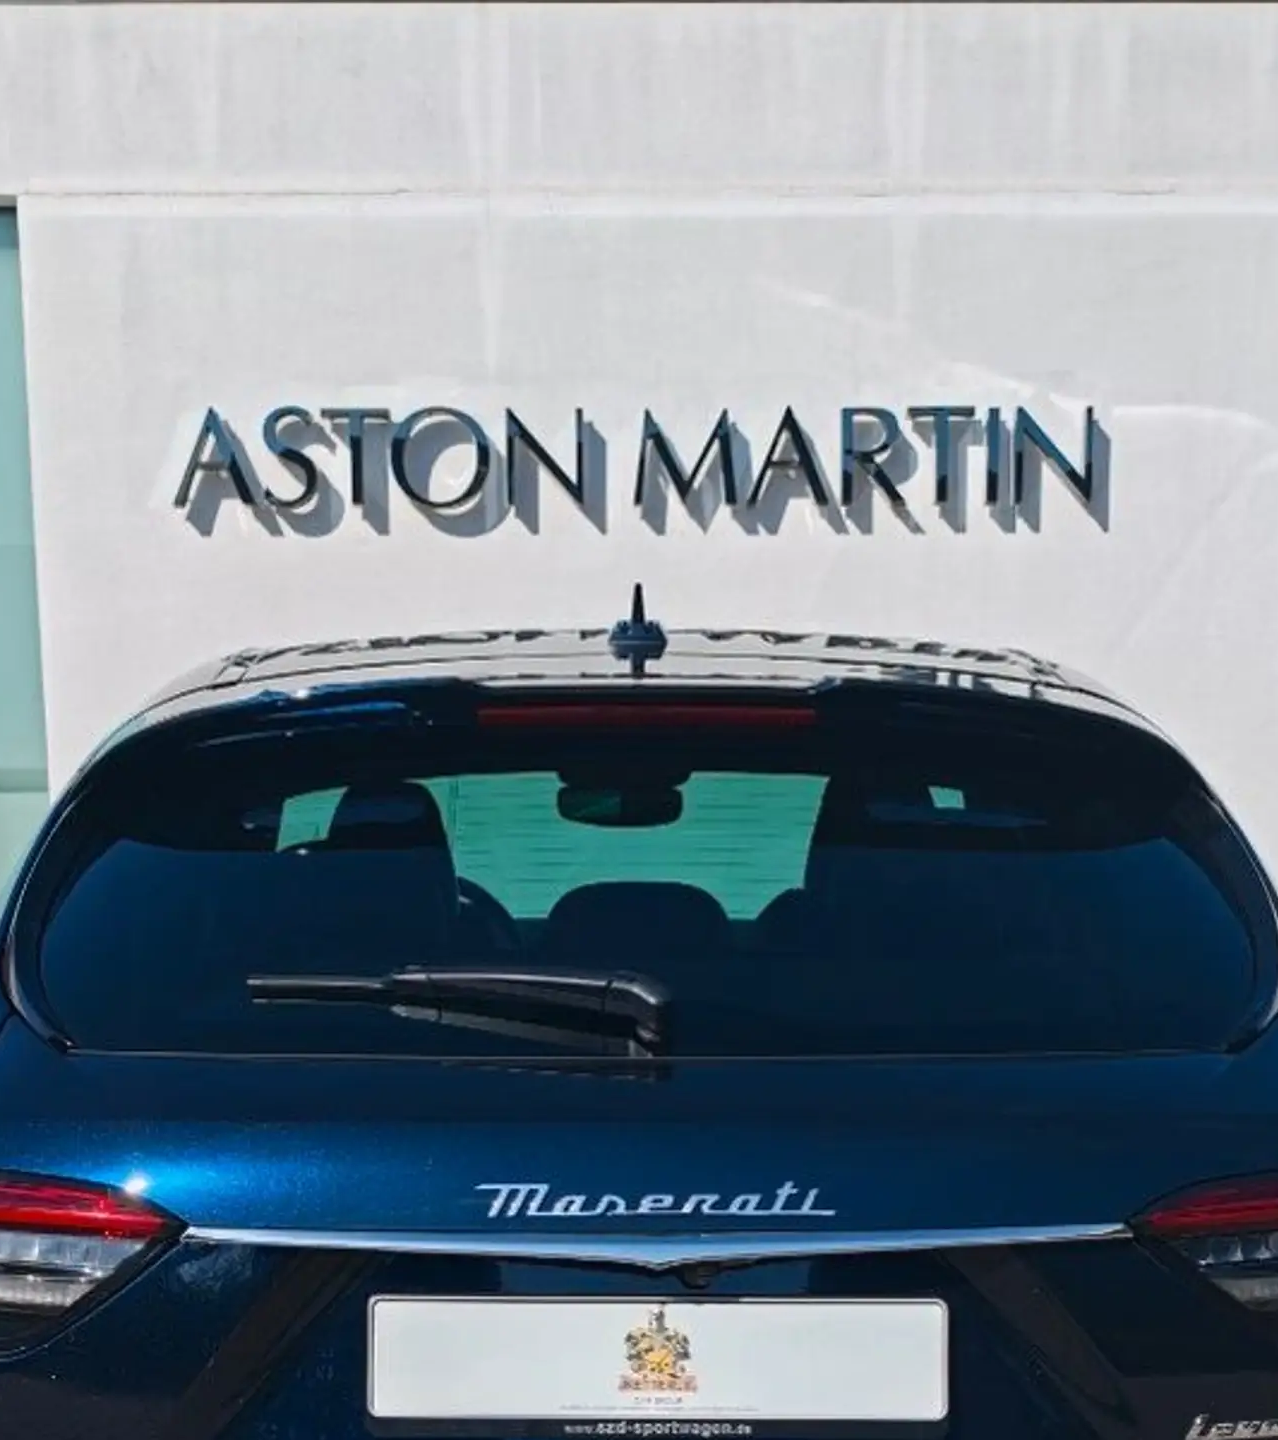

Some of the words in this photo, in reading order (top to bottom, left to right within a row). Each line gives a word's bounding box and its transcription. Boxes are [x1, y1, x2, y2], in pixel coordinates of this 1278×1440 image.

[173, 406, 586, 509] ASTON
[634, 405, 1096, 509] MARTIN
[475, 1181, 835, 1217] Maserati
